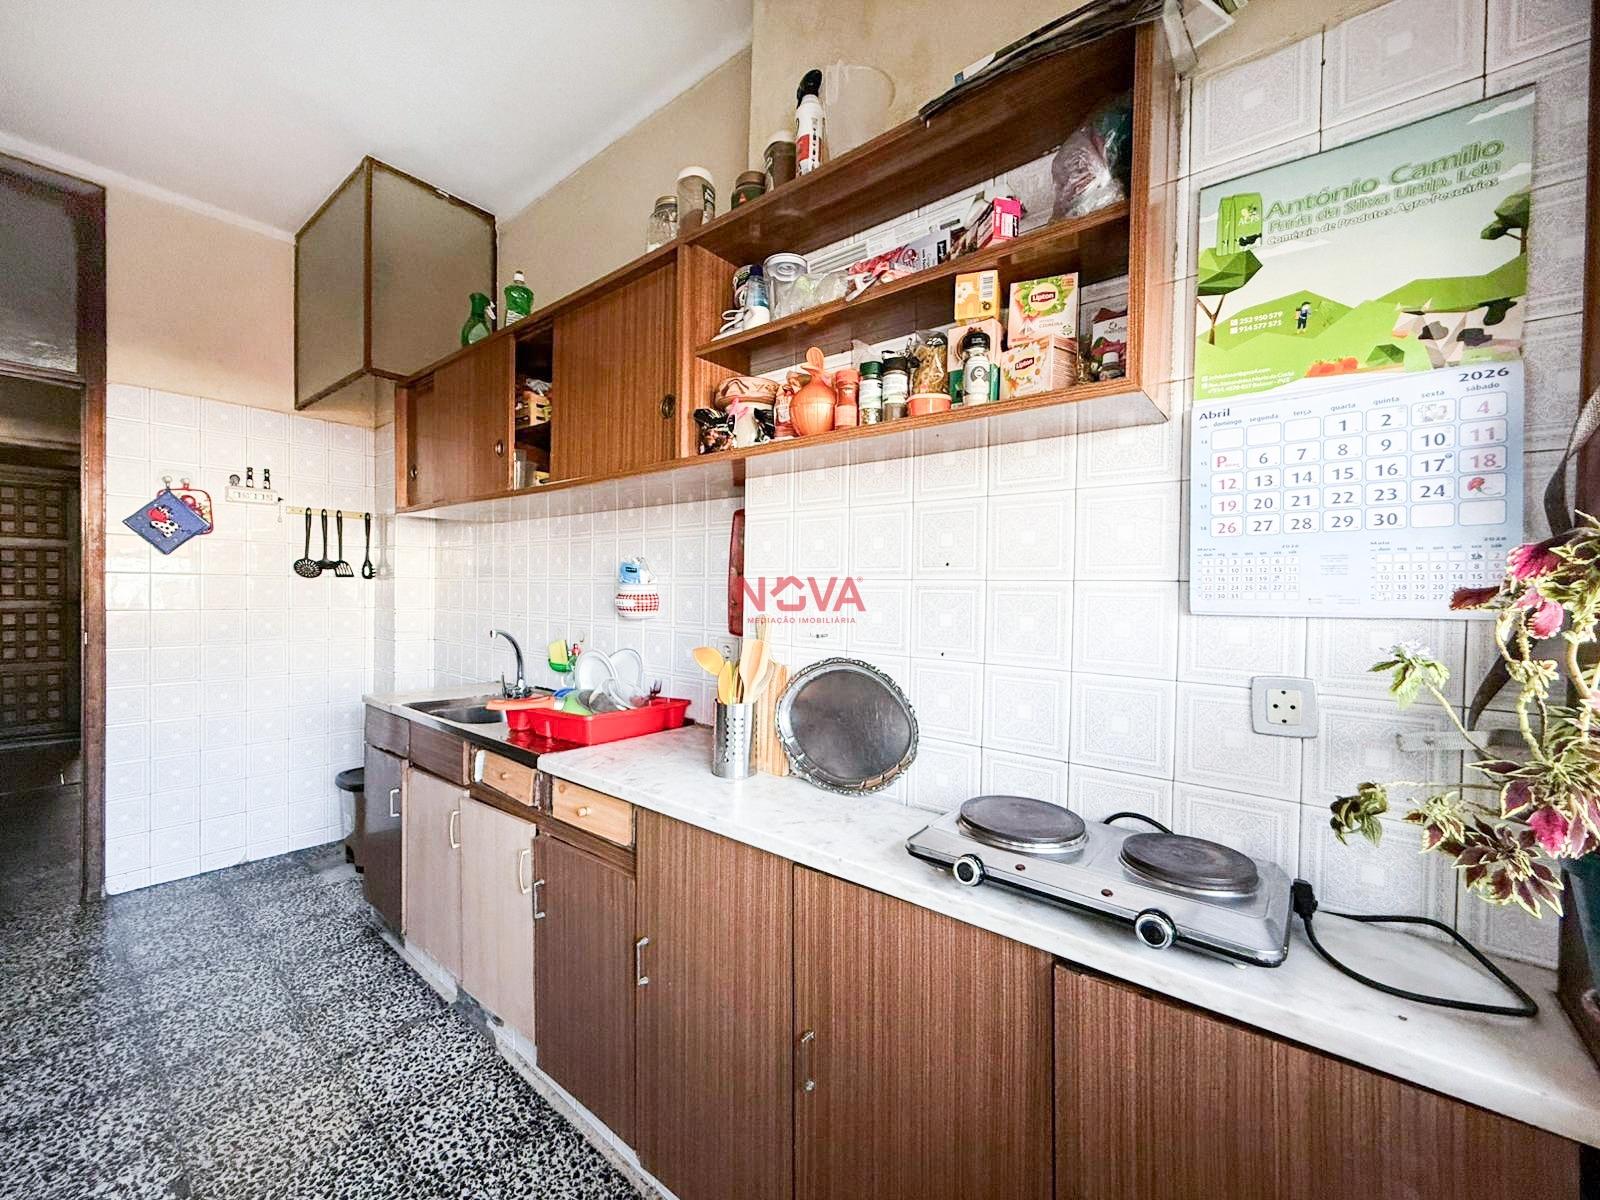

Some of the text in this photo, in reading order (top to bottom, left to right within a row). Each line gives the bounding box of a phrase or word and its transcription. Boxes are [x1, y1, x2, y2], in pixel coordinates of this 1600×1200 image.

[1266, 140, 1504, 219] António Camilo
[1343, 191, 1391, 215] Silva
[1320, 222, 1336, 234] de
[1337, 207, 1394, 230] Produtos
[1033, 293, 1054, 301] Lipton
[1016, 359, 1034, 369] Lipton
[1459, 367, 1508, 382] 2026
[1200, 407, 1230, 420] Abril
[1213, 420, 1242, 428] domingo
[1250, 414, 1278, 423] segunda
[1330, 403, 1356, 412] quarta
[1373, 397, 1400, 406] quinta
[1422, 391, 1445, 399] sexta
[1466, 382, 1500, 392] sábado
[1337, 420, 1345, 432] 1
[1382, 414, 1392, 427] 2
[1477, 401, 1490, 414] 4
[1259, 453, 1268, 464] 6
[1297, 448, 1307, 460] 7
[1338, 443, 1348, 456] 8
[1381, 439, 1391, 451] 9
[1420, 433, 1446, 447] 10
[1472, 427, 1494, 441] 11
[1219, 478, 1236, 490] 12
[1254, 475, 1273, 487] 13
[1292, 471, 1312, 484] 14
[1332, 467, 1354, 480] 15
[1375, 463, 1398, 477] 16
[1420, 459, 1444, 473] 17
[1470, 454, 1496, 469] 18
[1219, 500, 1237, 512] 19
[1254, 498, 1273, 510] 20
[1292, 495, 1311, 507] 21
[1332, 491, 1354, 504] 22
[1375, 488, 1397, 501] 23
[1420, 485, 1445, 498] 24
[1218, 522, 1237, 534] 26
[1253, 520, 1273, 532] 27
[1291, 517, 1312, 530] 28
[1331, 515, 1354, 528] 29
[1374, 513, 1398, 526] 30
[1472, 572, 1483, 580] 15
